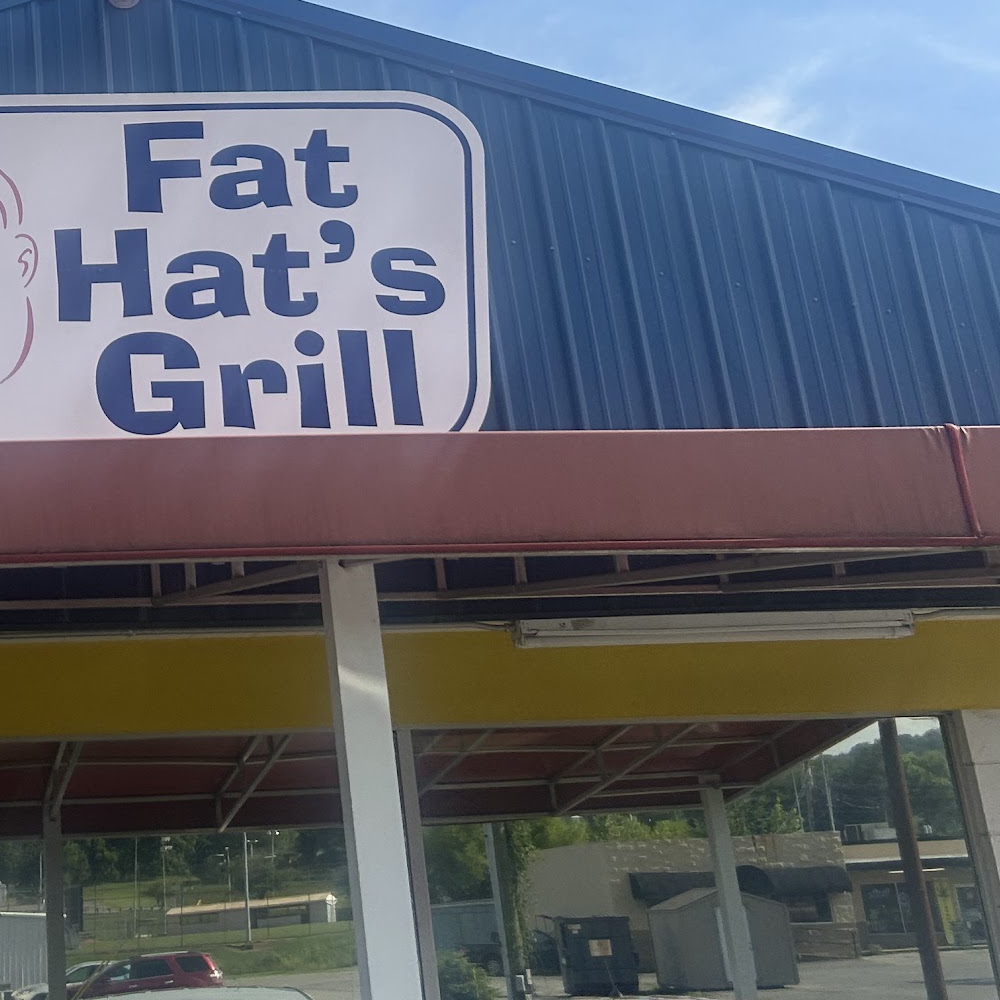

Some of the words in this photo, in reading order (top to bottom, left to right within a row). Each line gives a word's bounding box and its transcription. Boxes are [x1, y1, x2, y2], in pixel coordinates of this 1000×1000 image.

[123, 120, 359, 214] Fat
[53, 219, 446, 322] Hat's
[95, 329, 424, 436] Grill
